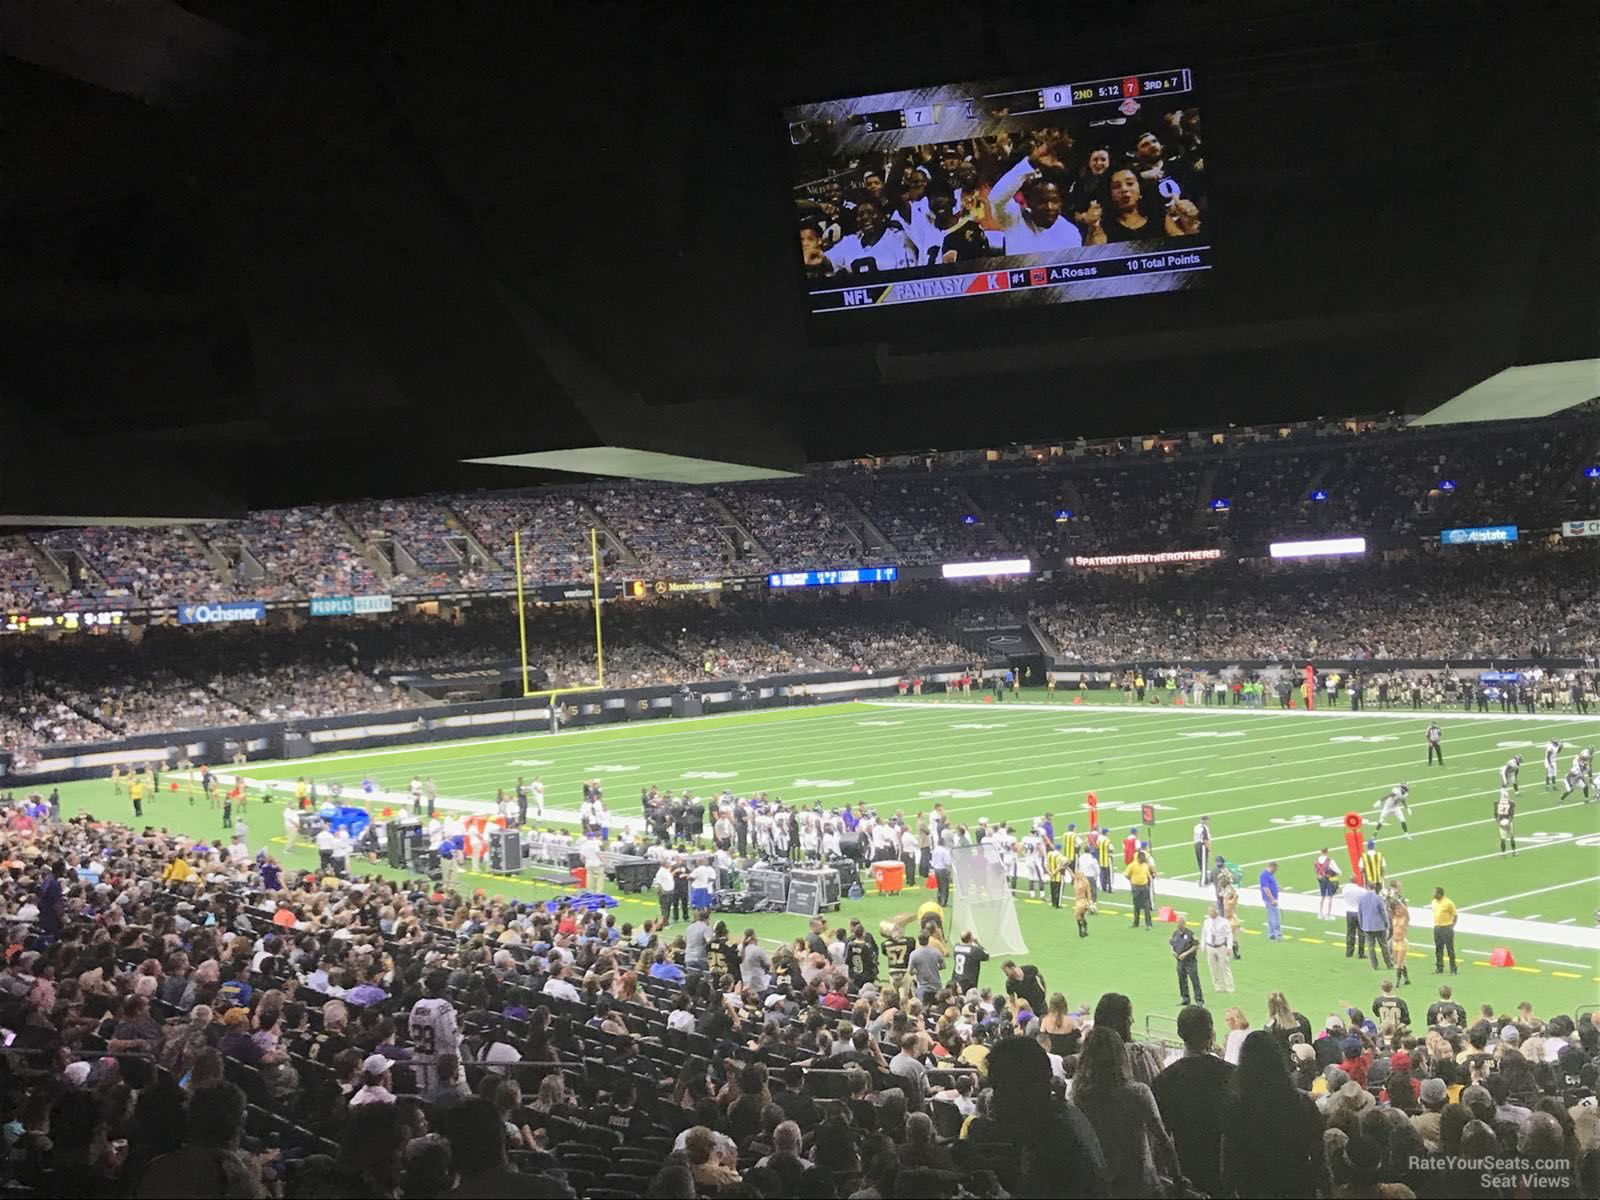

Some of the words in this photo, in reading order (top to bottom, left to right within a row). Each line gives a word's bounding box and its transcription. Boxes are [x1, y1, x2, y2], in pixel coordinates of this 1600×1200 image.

[1053, 92, 1062, 103] 0
[1073, 88, 1093, 100] 2ND
[1098, 85, 1119, 97] 5:12
[1127, 83, 1134, 93] 7
[1143, 80, 1162, 91] 3RD
[1171, 77, 1178, 87] 7
[914, 111, 922, 122] 7
[842, 290, 873, 306] NFL
[894, 277, 966, 300] FANTASY
[986, 273, 1000, 290] K
[1011, 271, 1026, 284] #1
[1049, 266, 1098, 280] A.Rosas
[1126, 259, 1139, 271] 10
[1140, 257, 1166, 269] Total
[1167, 253, 1201, 266] Points
[1467, 529, 1508, 541] Allstate
[195, 604, 260, 623] Ochsner
[1143, 806, 1153, 823] 3
[1497, 803, 1511, 815] 27
[852, 954, 864, 974] 9
[886, 944, 908, 965] 57
[955, 953, 966, 975] 8
